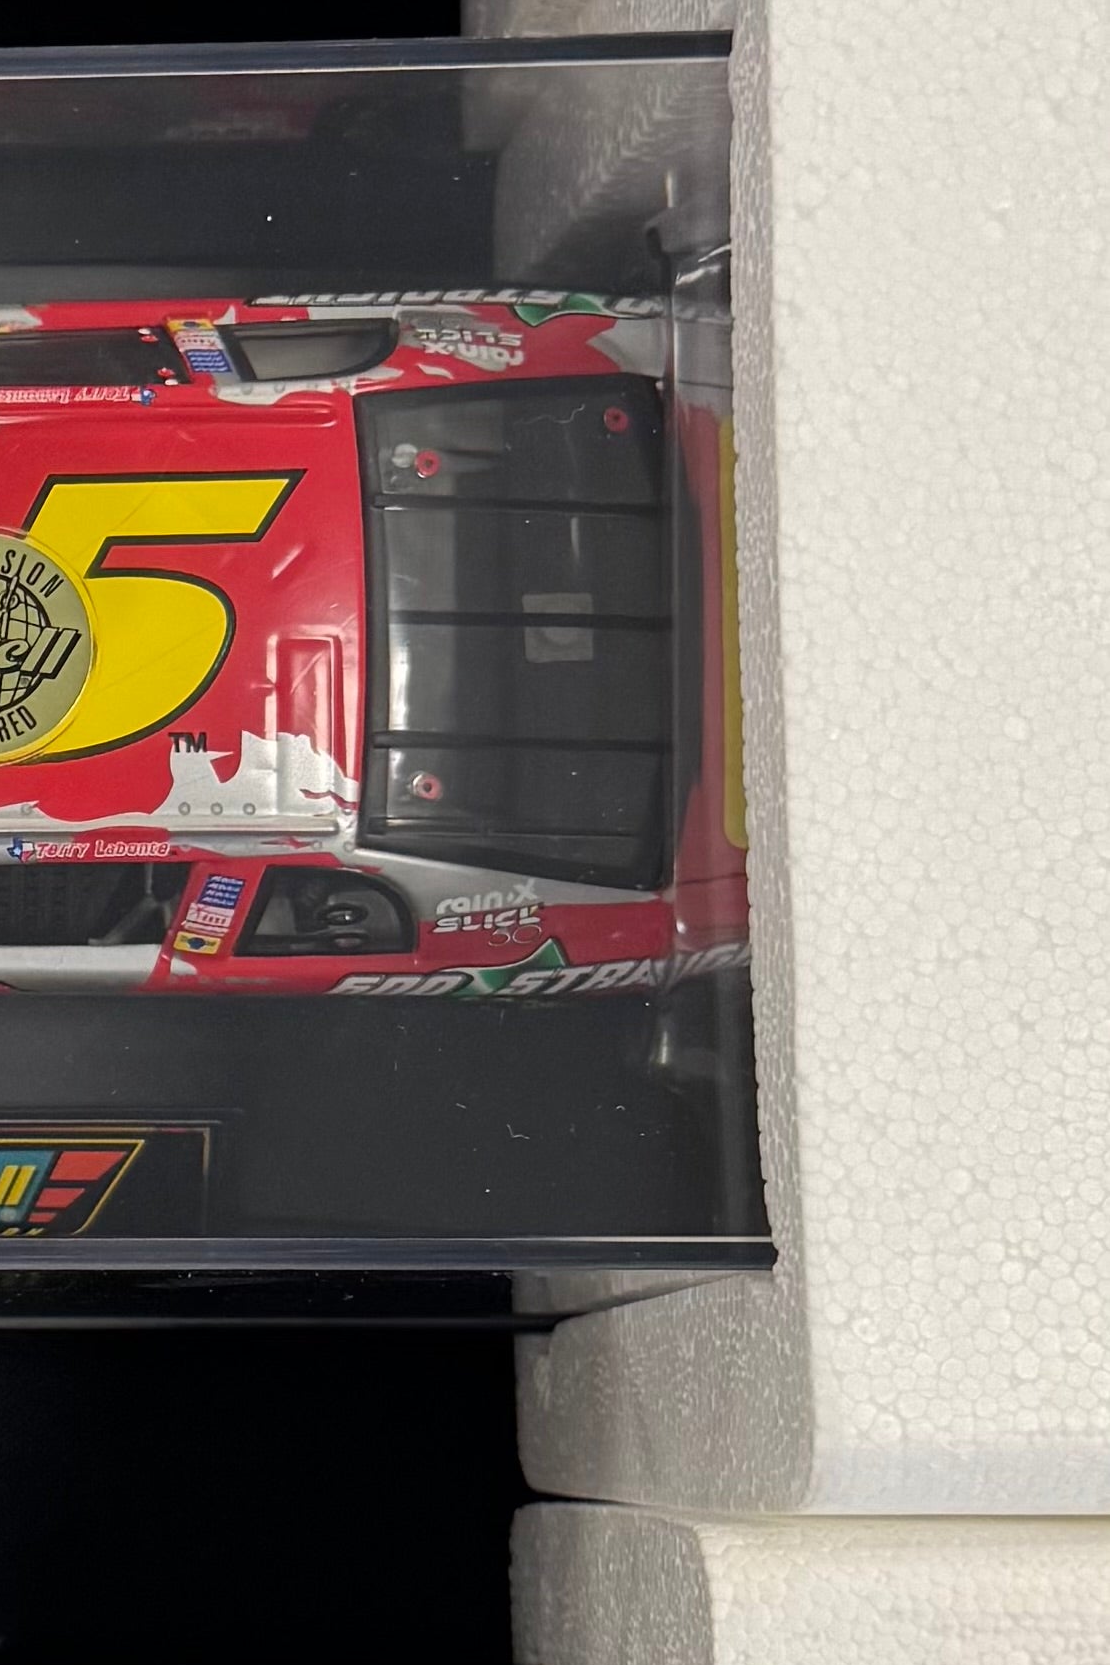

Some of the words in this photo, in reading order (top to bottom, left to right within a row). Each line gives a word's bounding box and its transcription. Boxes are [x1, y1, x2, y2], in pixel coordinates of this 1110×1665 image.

[170, 732, 208, 754] TM
[35, 840, 89, 862] Terry
[93, 839, 170, 858] Labonte
